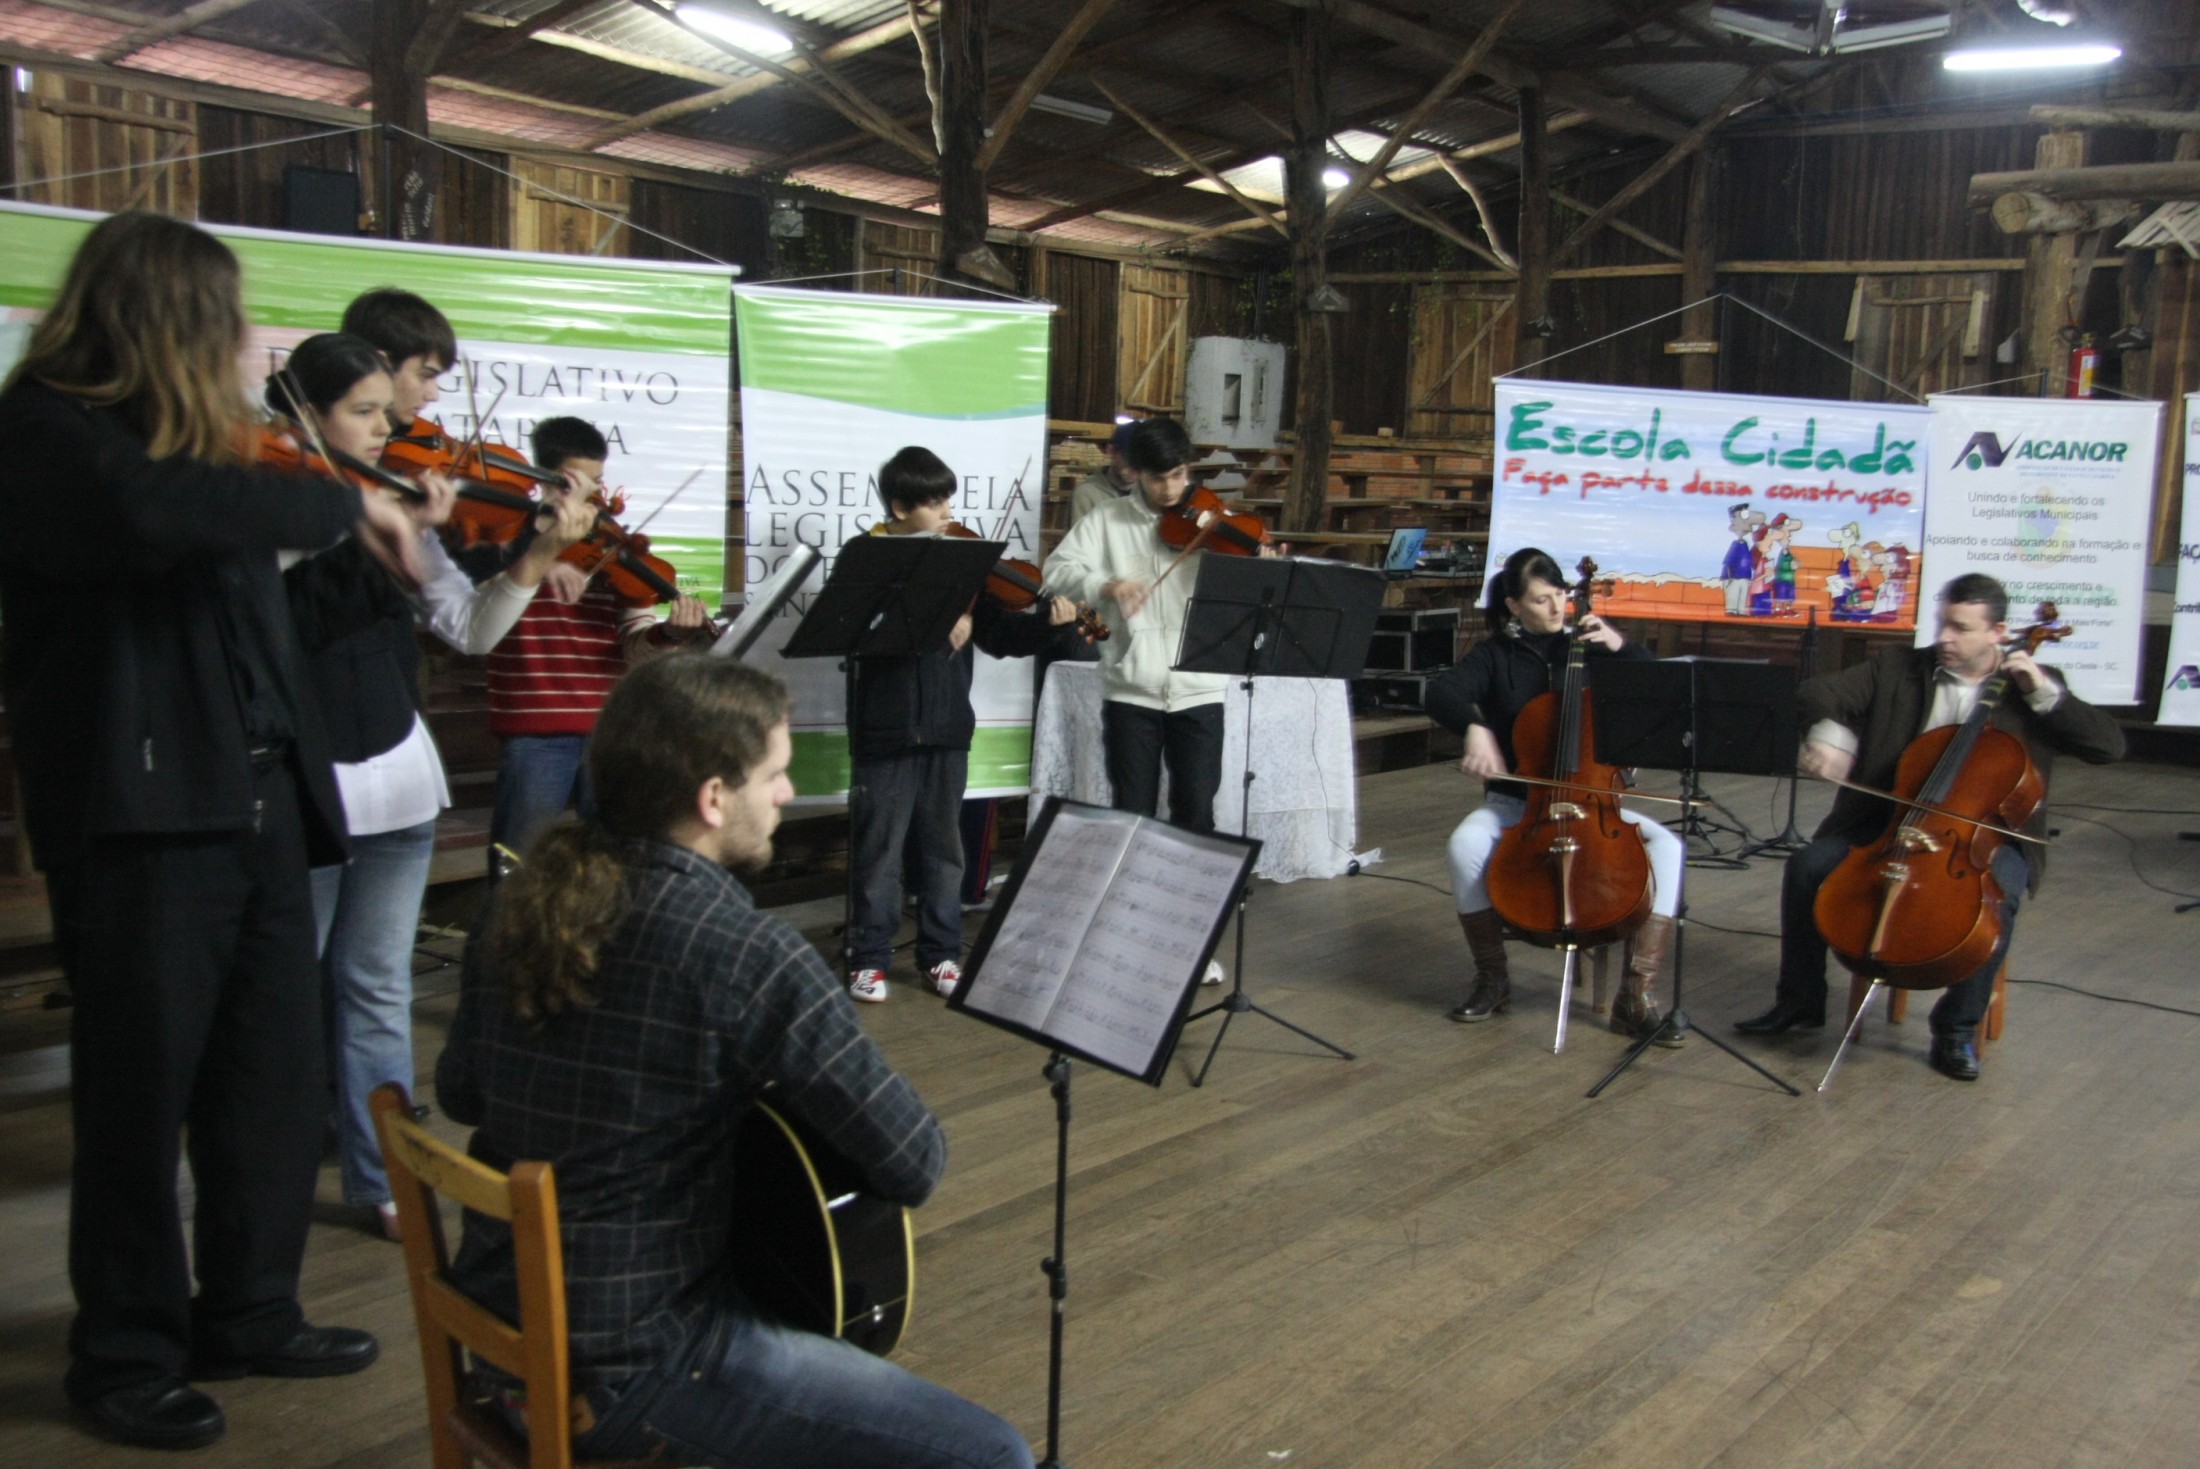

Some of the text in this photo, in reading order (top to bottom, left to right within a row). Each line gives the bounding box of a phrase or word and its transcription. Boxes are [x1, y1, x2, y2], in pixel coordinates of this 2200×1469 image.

[436, 359, 679, 406] GISLATIVO
[1504, 401, 1917, 475] Escola Cidadã
[2015, 440, 2129, 463] ACANOR
[746, 463, 1033, 512] ASSEMEIA
[1502, 458, 1913, 514] Faça parte dessa construção
[1967, 492, 2008, 504] Unindo
[2010, 495, 2017, 504] e
[2020, 493, 2089, 506] fortalecendo
[1972, 507, 2098, 521] Legislativos Municipais
[1925, 534, 1978, 549] Apoiando
[1991, 537, 2059, 549] colaborando
[2062, 540, 2076, 550] na
[2079, 538, 2129, 552] formação
[1967, 550, 2097, 563] busca de conhecimento
[2026, 581, 2093, 591] crescimento
